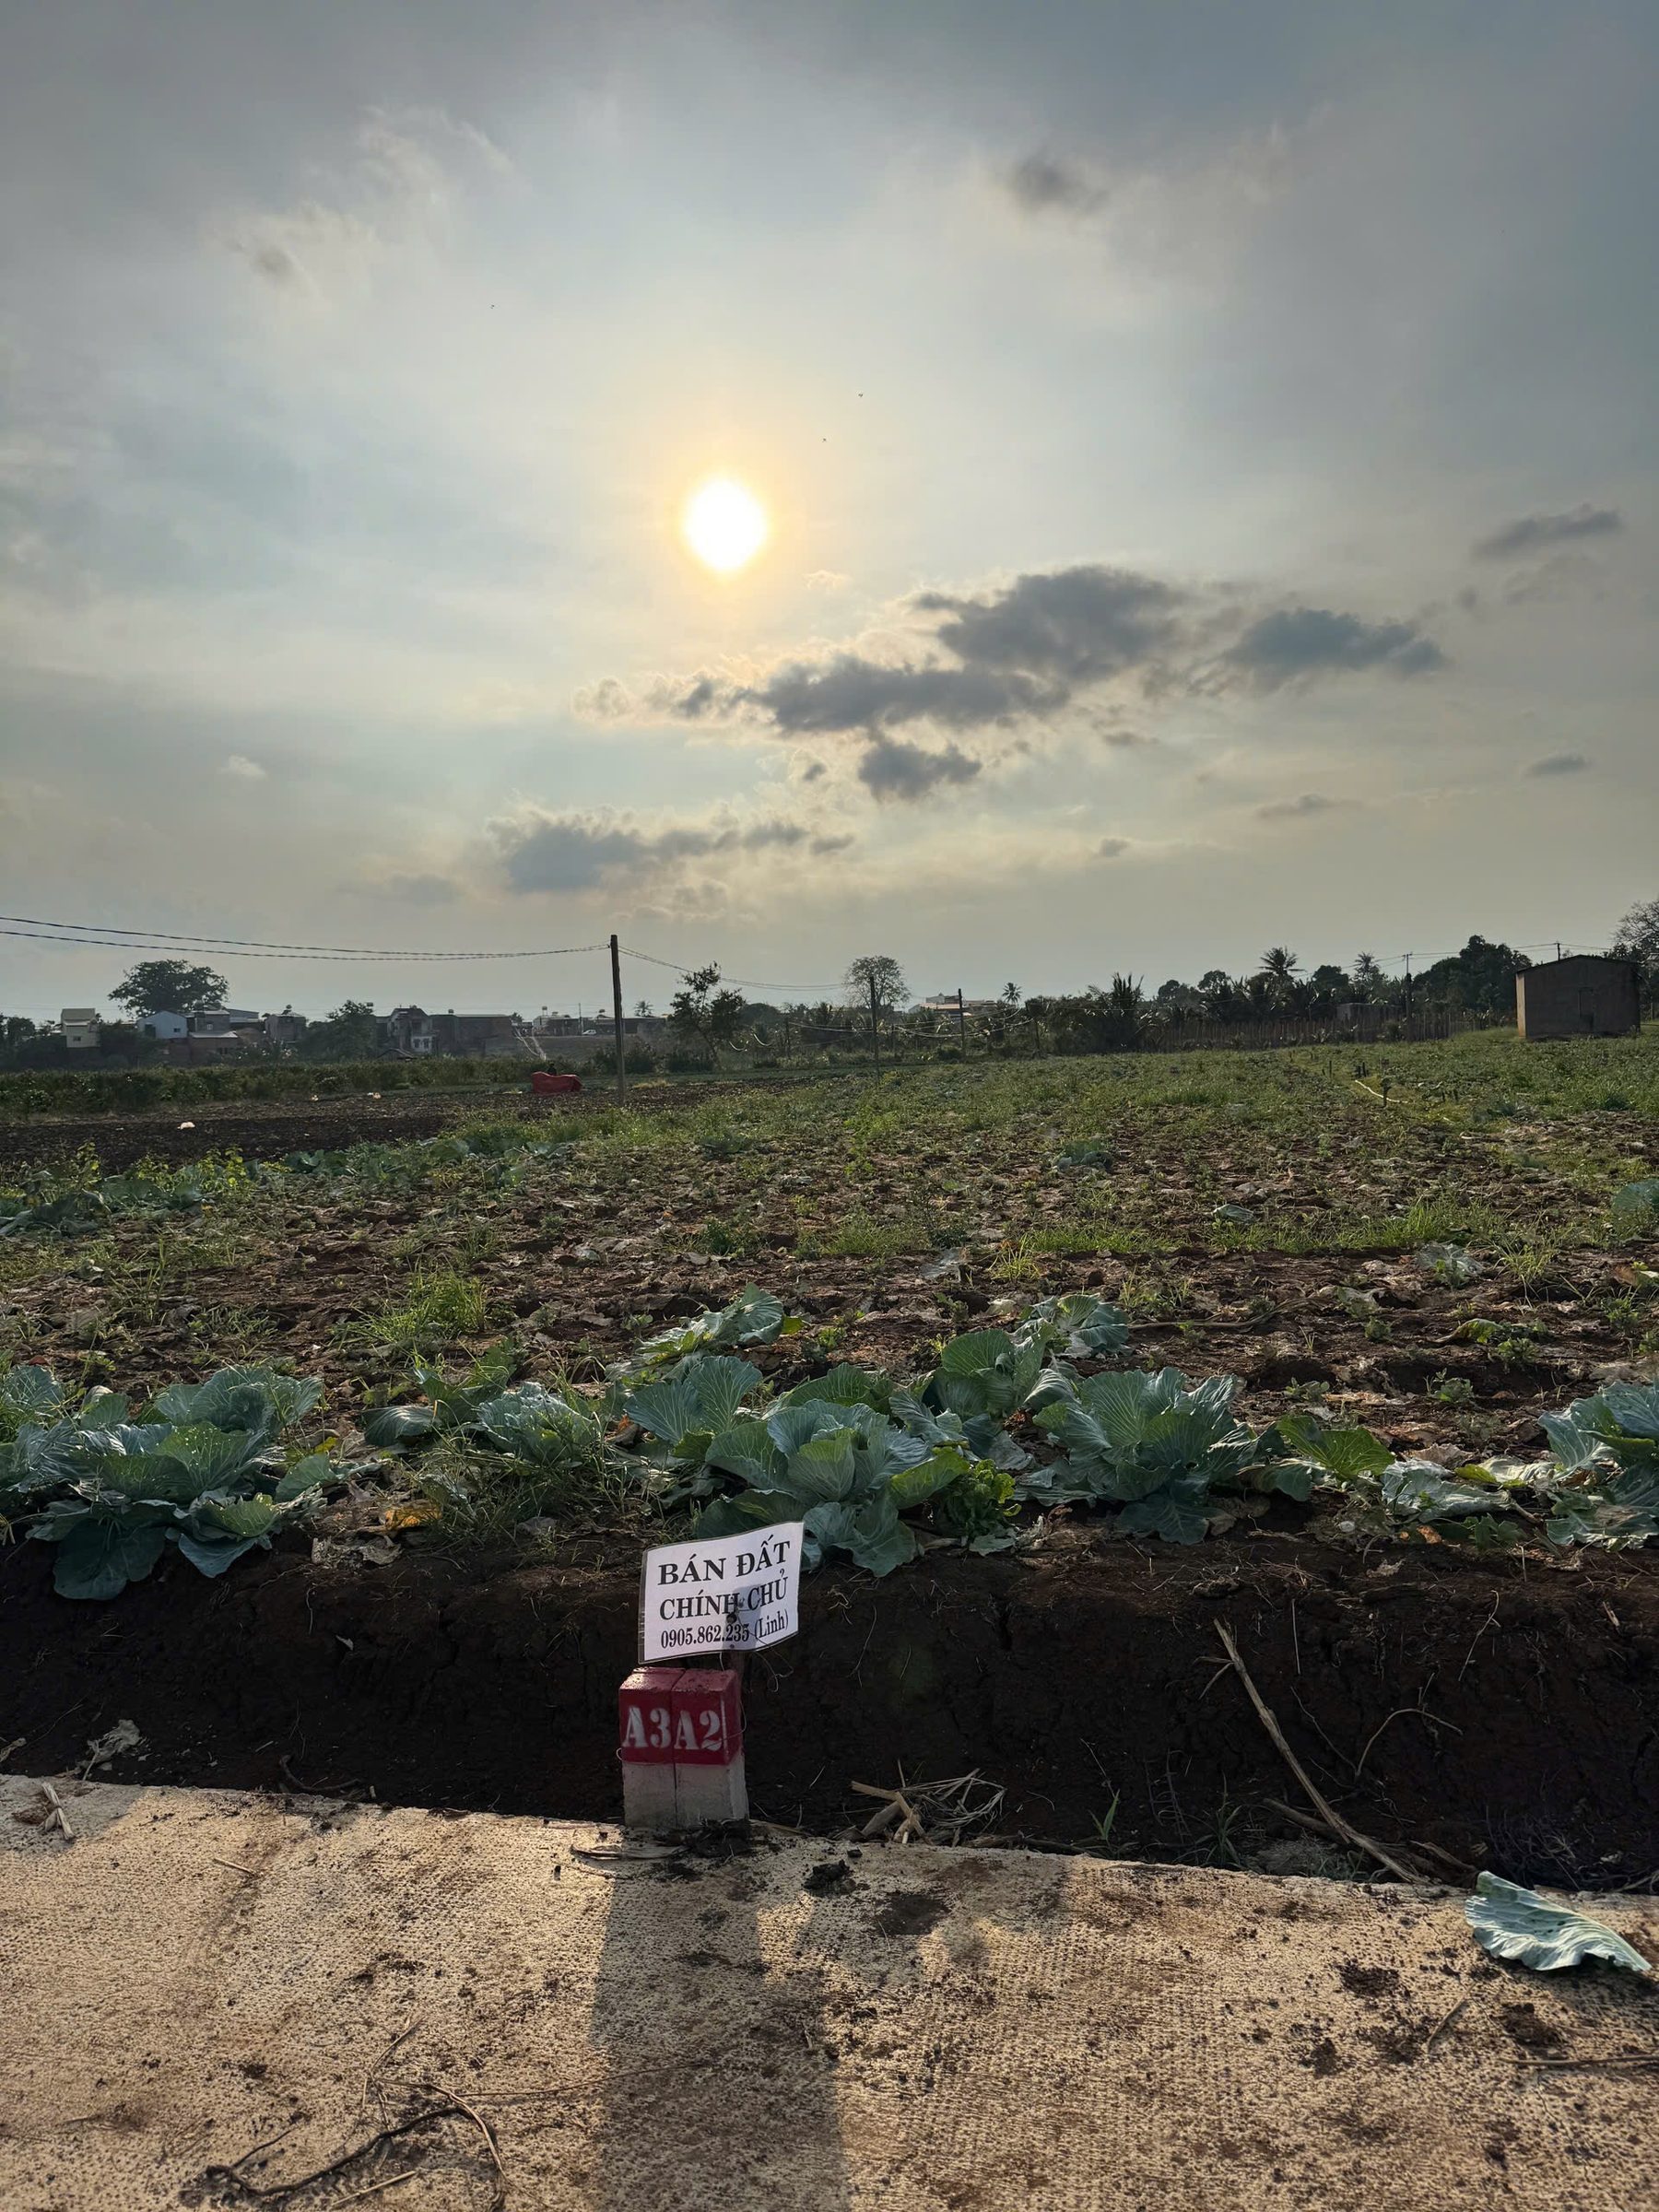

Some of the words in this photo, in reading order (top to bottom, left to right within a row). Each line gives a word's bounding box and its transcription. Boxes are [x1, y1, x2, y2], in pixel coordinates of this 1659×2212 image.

[657, 1553, 726, 1585] BÁN
[735, 1534, 791, 1577] ĐẤT
[659, 1589, 740, 1620] CHÍNH
[747, 1568, 789, 1611] CHỦ
[661, 1624, 750, 1650] 0905.862.235
[754, 1609, 790, 1641] (Linh)
